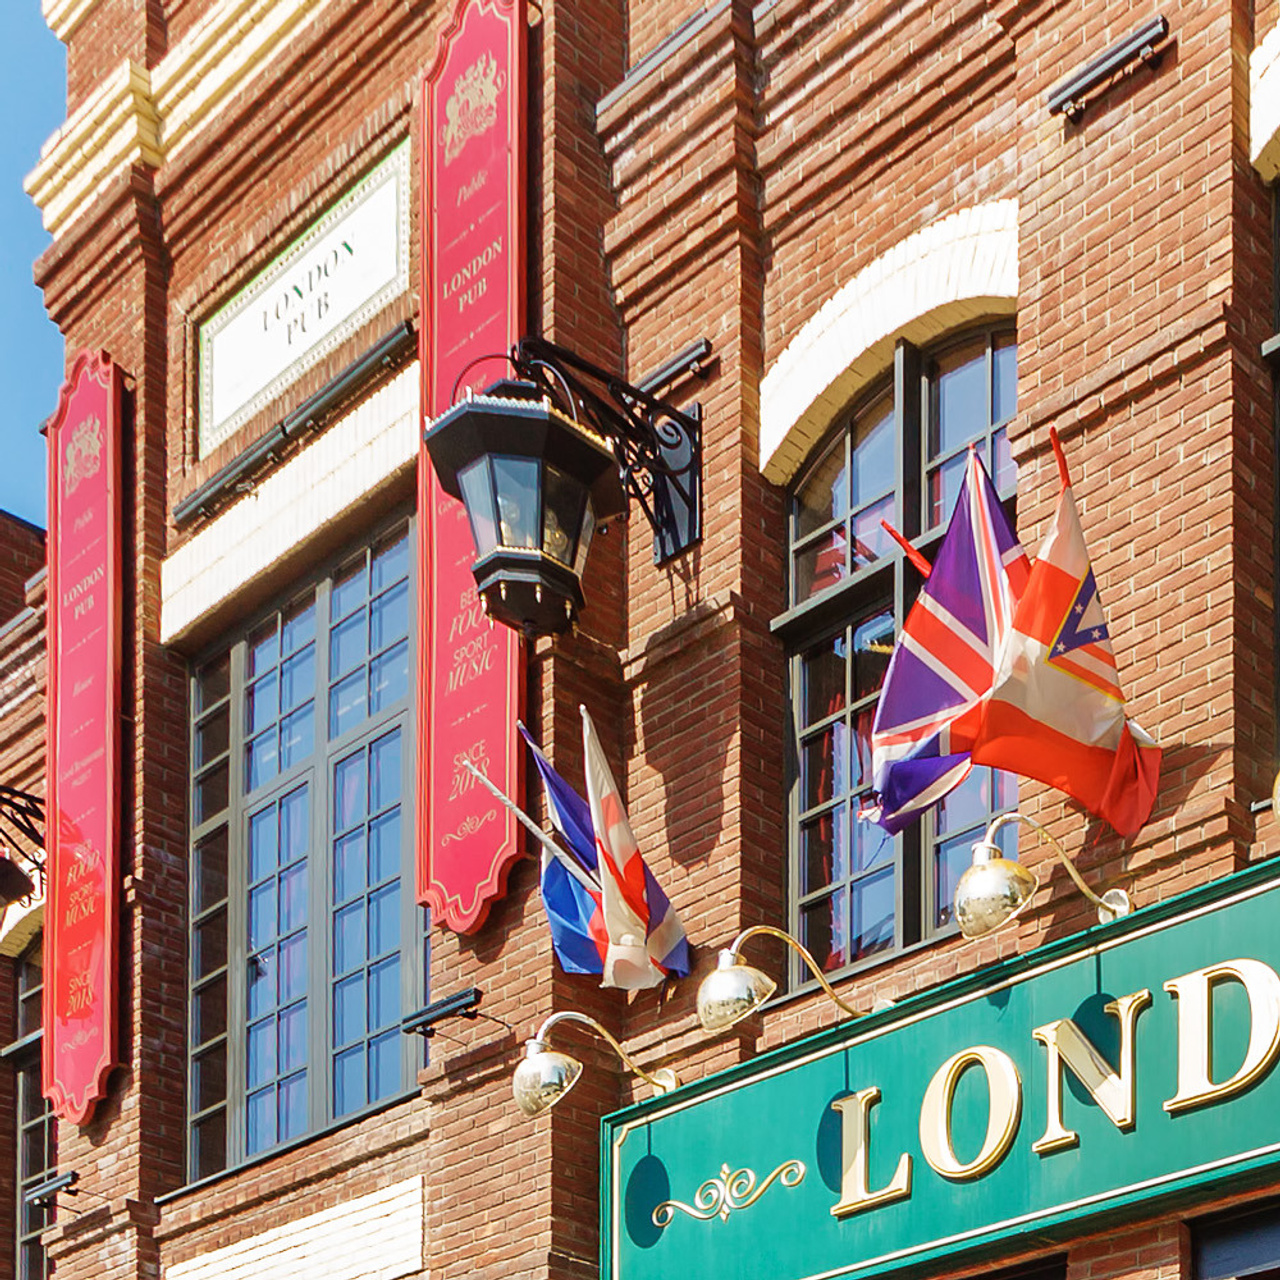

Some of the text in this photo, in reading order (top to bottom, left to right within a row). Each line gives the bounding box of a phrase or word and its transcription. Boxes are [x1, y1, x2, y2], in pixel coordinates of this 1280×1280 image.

[443, 236, 503, 300] LONDON
[458, 278, 488, 313] PUB
[286, 291, 329, 345] PUB
[63, 564, 105, 608] LONDON
[460, 585, 479, 610] BEE
[74, 595, 95, 620] PUB
[453, 630, 489, 668] SPORT
[445, 643, 498, 697] MUSIC
[453, 738, 486, 773] SINCE
